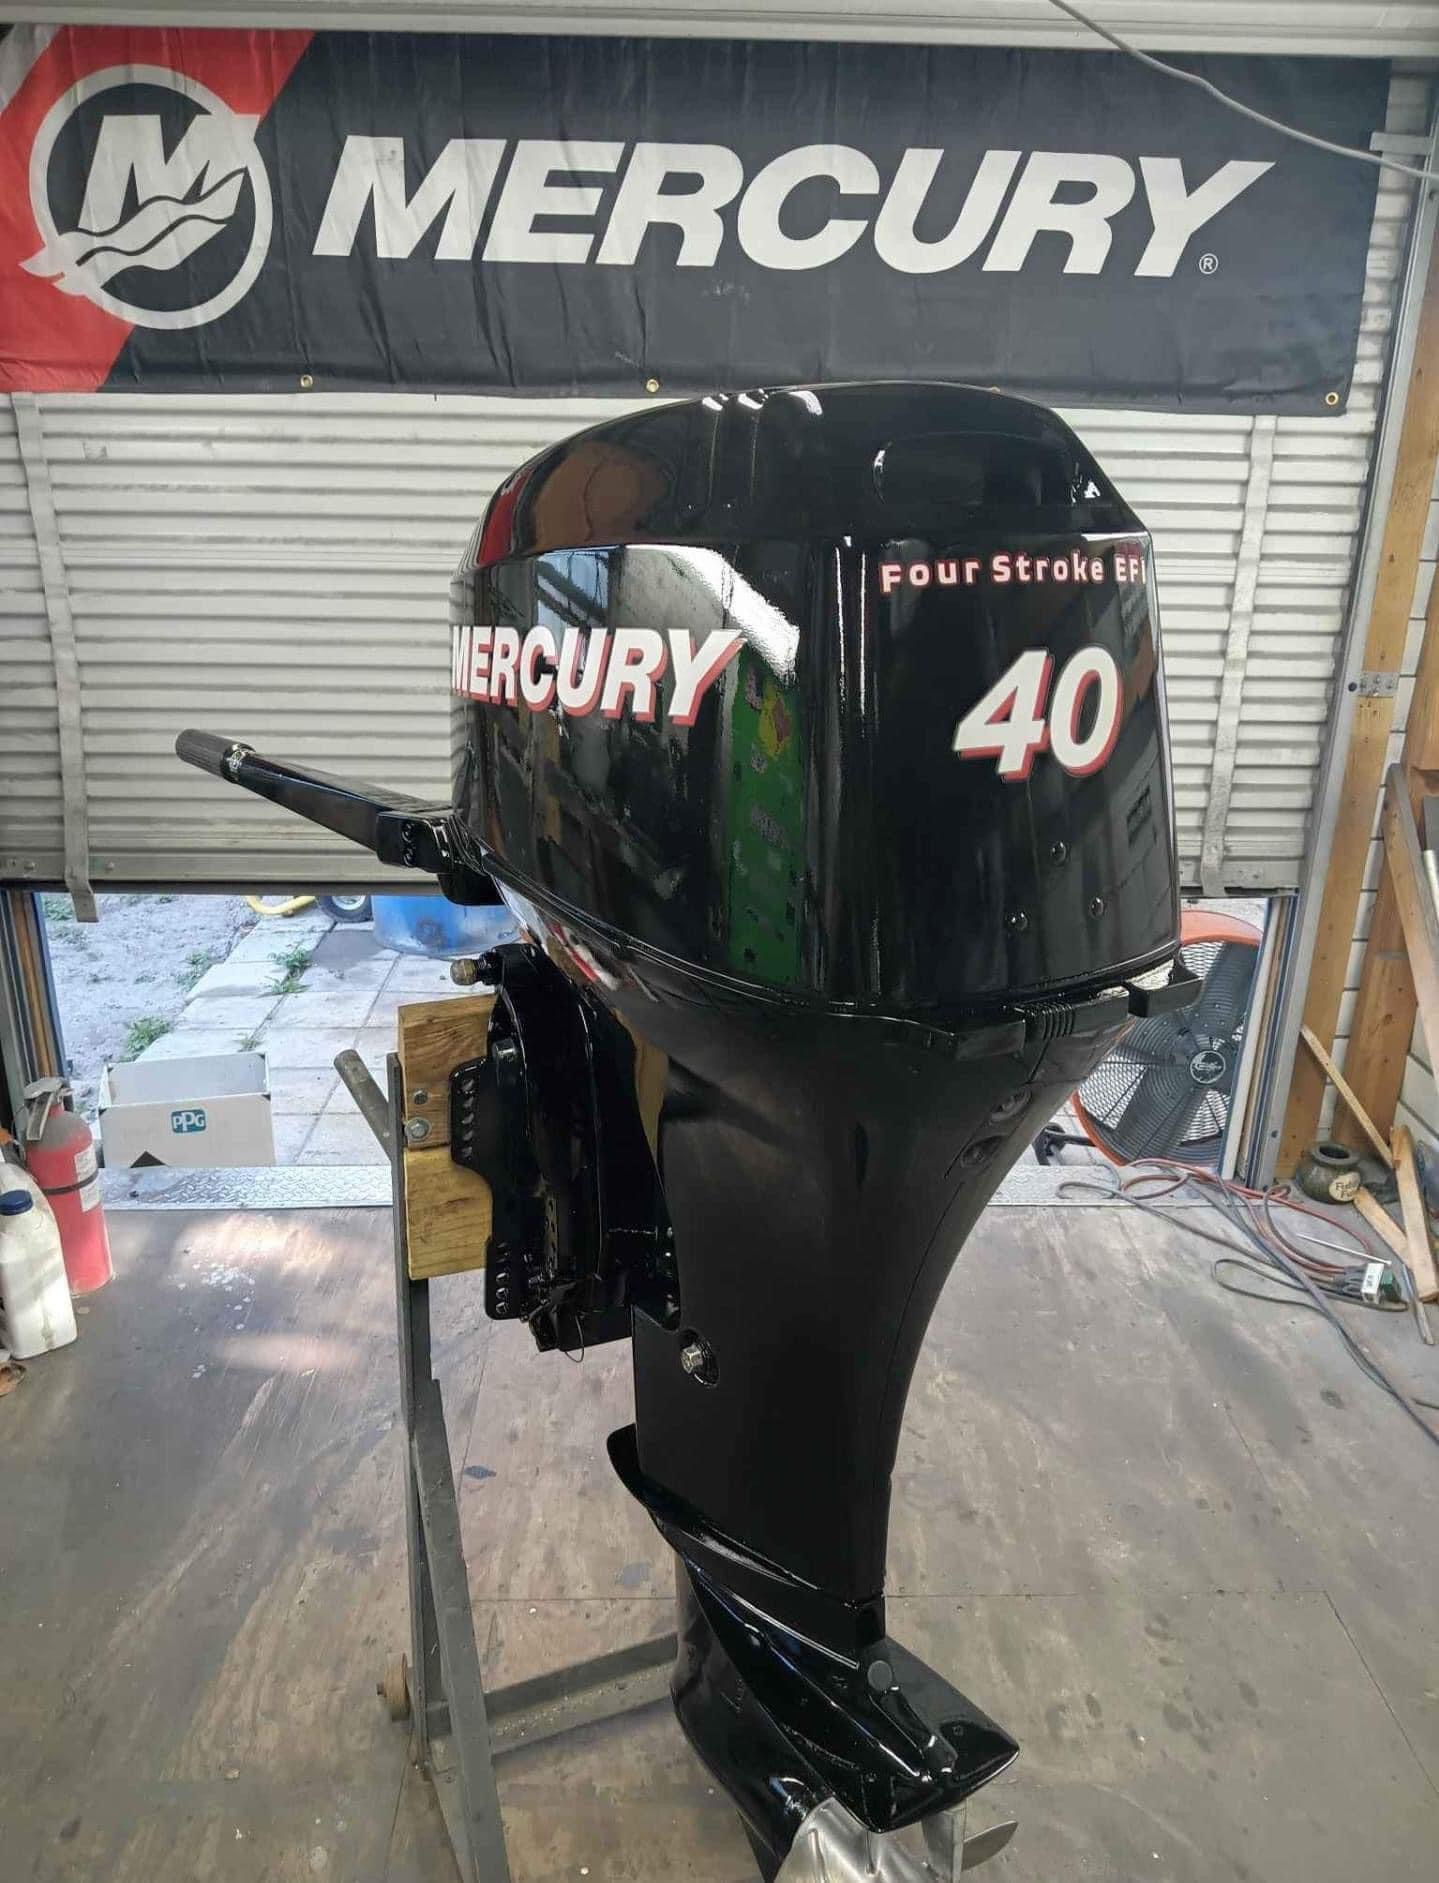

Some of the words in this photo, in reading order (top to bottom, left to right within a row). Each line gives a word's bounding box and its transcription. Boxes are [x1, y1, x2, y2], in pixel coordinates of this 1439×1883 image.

[312, 135, 1276, 278] MERCURY
[880, 560, 980, 593] Four
[992, 553, 1104, 583] Stroke
[451, 624, 748, 727] MERCURY
[953, 647, 1123, 782] 40
[172, 1111, 206, 1131] PPG
